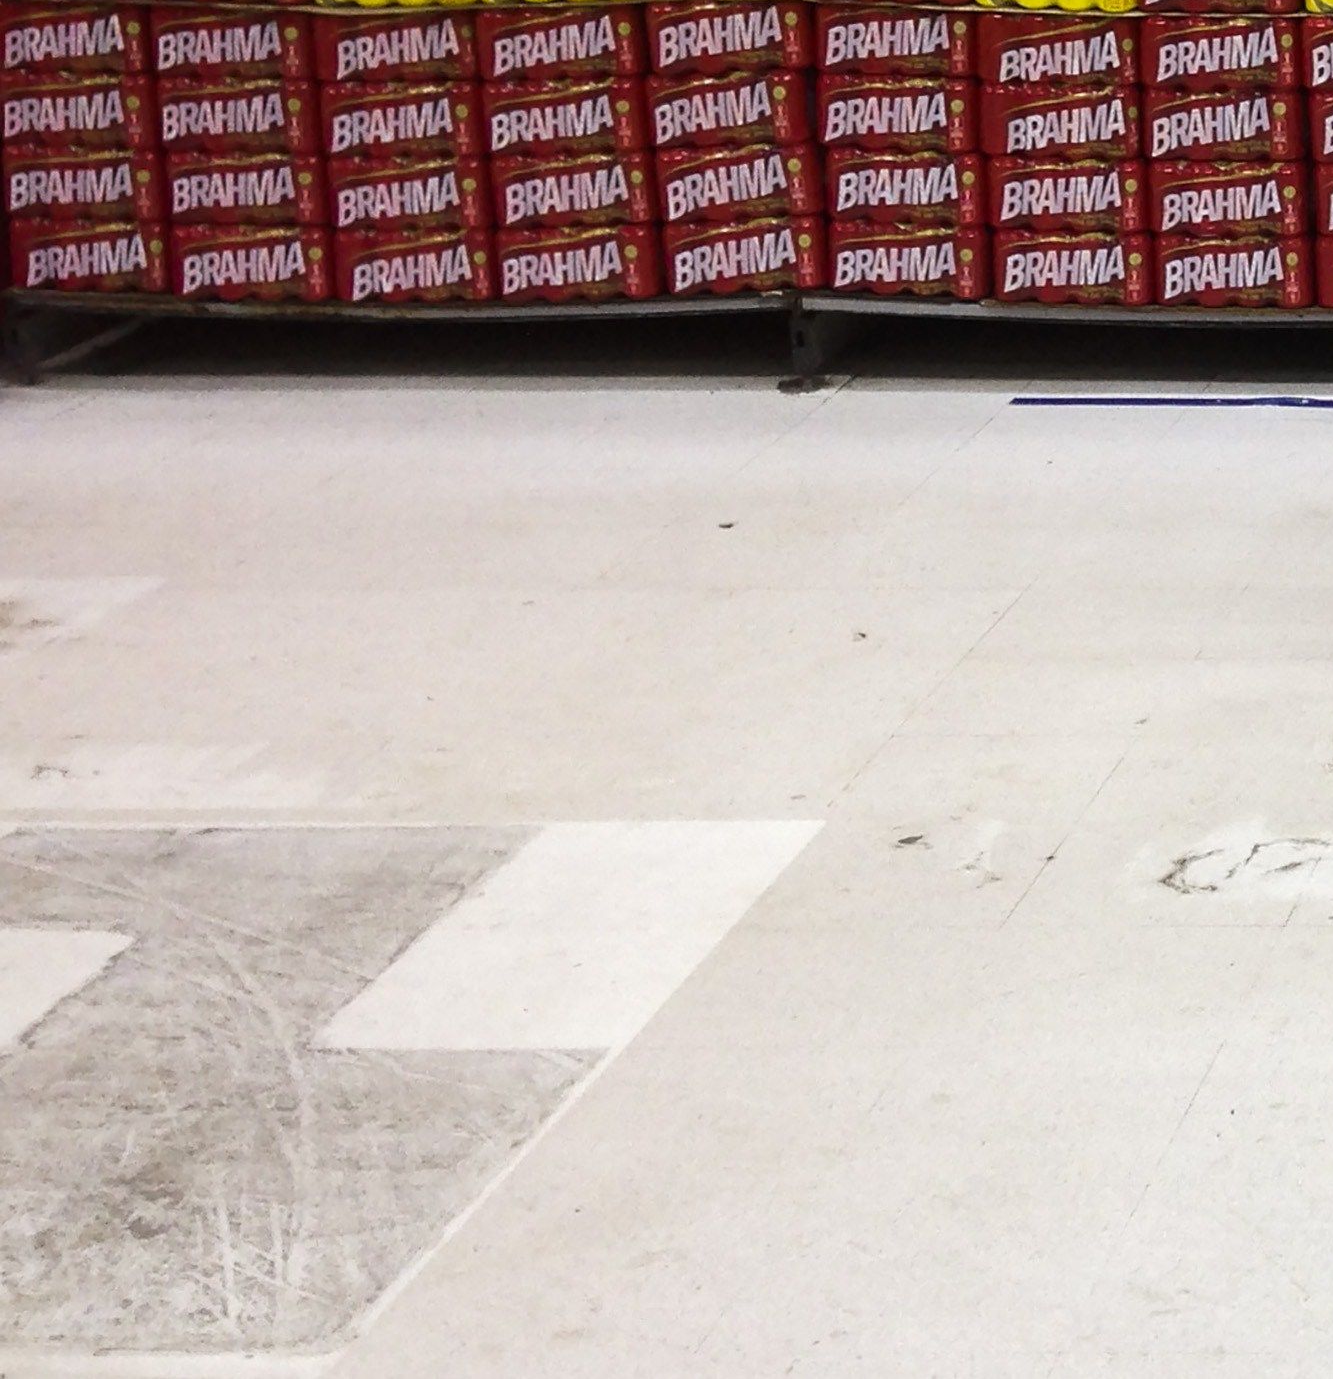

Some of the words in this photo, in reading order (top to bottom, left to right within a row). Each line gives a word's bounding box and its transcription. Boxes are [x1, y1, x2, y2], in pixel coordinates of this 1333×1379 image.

[5, 15, 124, 67] BRAHMA
[660, 6, 782, 67] BRAHMA
[1157, 27, 1278, 82] BRAHMA
[332, 98, 453, 152] BRAHMA
[825, 93, 947, 141] BRAHMA
[1008, 99, 1125, 153] BRAHMA
[174, 167, 295, 212] BRAHMA
[506, 165, 628, 224] BRAHMA
[1162, 180, 1281, 230] BRAHMA
[28, 234, 147, 285] BRAHMA
[353, 245, 472, 300] BRAHMA
[675, 229, 796, 291] BRAHMA
[1004, 245, 1124, 292] BRAHMA
